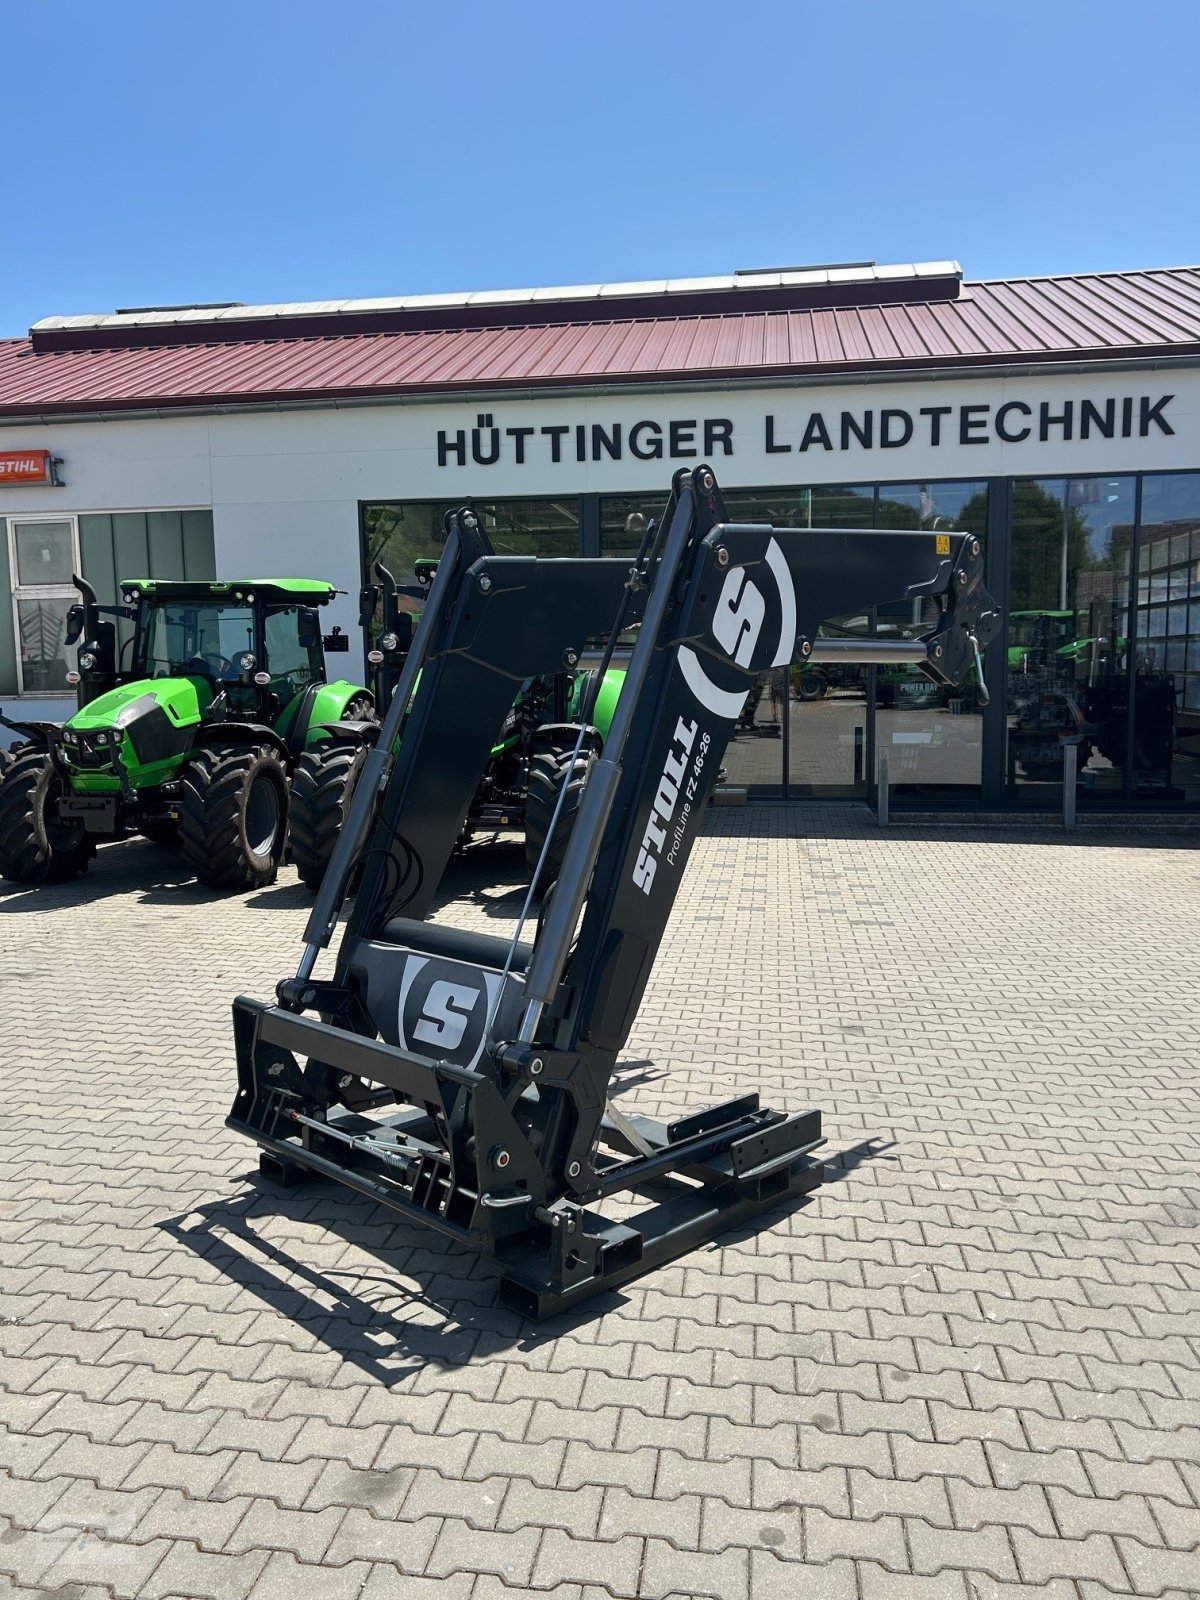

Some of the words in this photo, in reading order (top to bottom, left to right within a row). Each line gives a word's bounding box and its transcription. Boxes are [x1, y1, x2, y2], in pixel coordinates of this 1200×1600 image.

[0, 460, 39, 473] STIHL
[437, 413, 734, 467] HÜTTINGER
[765, 394, 1176, 454] LANDTECHNIK
[712, 566, 765, 669] S
[632, 715, 698, 896] STOLL
[666, 802, 691, 866] ProfiLine
[685, 776, 698, 801] FZ
[693, 732, 711, 777] 46-26
[413, 980, 480, 1050] S
